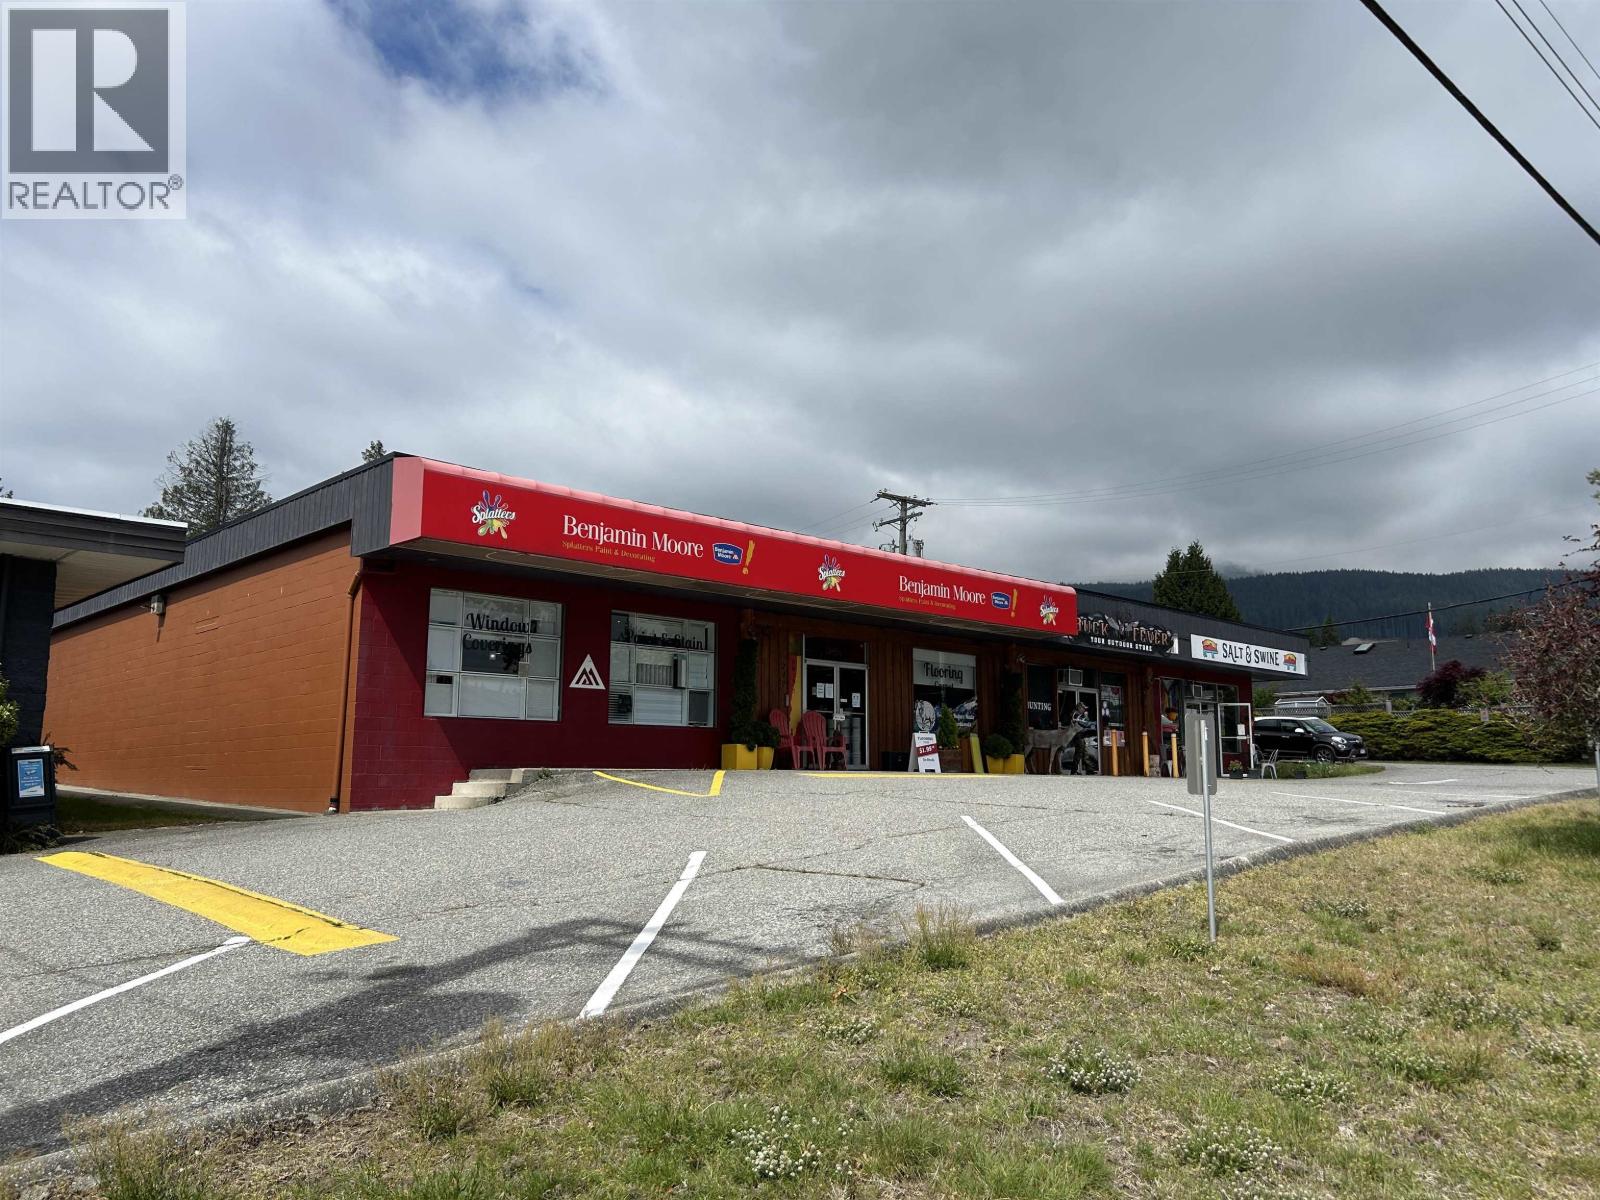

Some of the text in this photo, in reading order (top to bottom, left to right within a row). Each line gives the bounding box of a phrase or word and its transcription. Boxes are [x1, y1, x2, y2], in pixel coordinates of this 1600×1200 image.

[472, 504, 516, 524] Splatters
[563, 514, 704, 558] Benjamin Moore
[562, 540, 656, 563] Splatters Paint & Decorating
[899, 575, 950, 598] Benjamin
[953, 585, 986, 605] Moore
[1090, 636, 1105, 645] YOUR
[1132, 627, 1169, 646] FEVER
[1222, 642, 1280, 666] SALT & SWINE
[924, 662, 964, 684] Flooring
